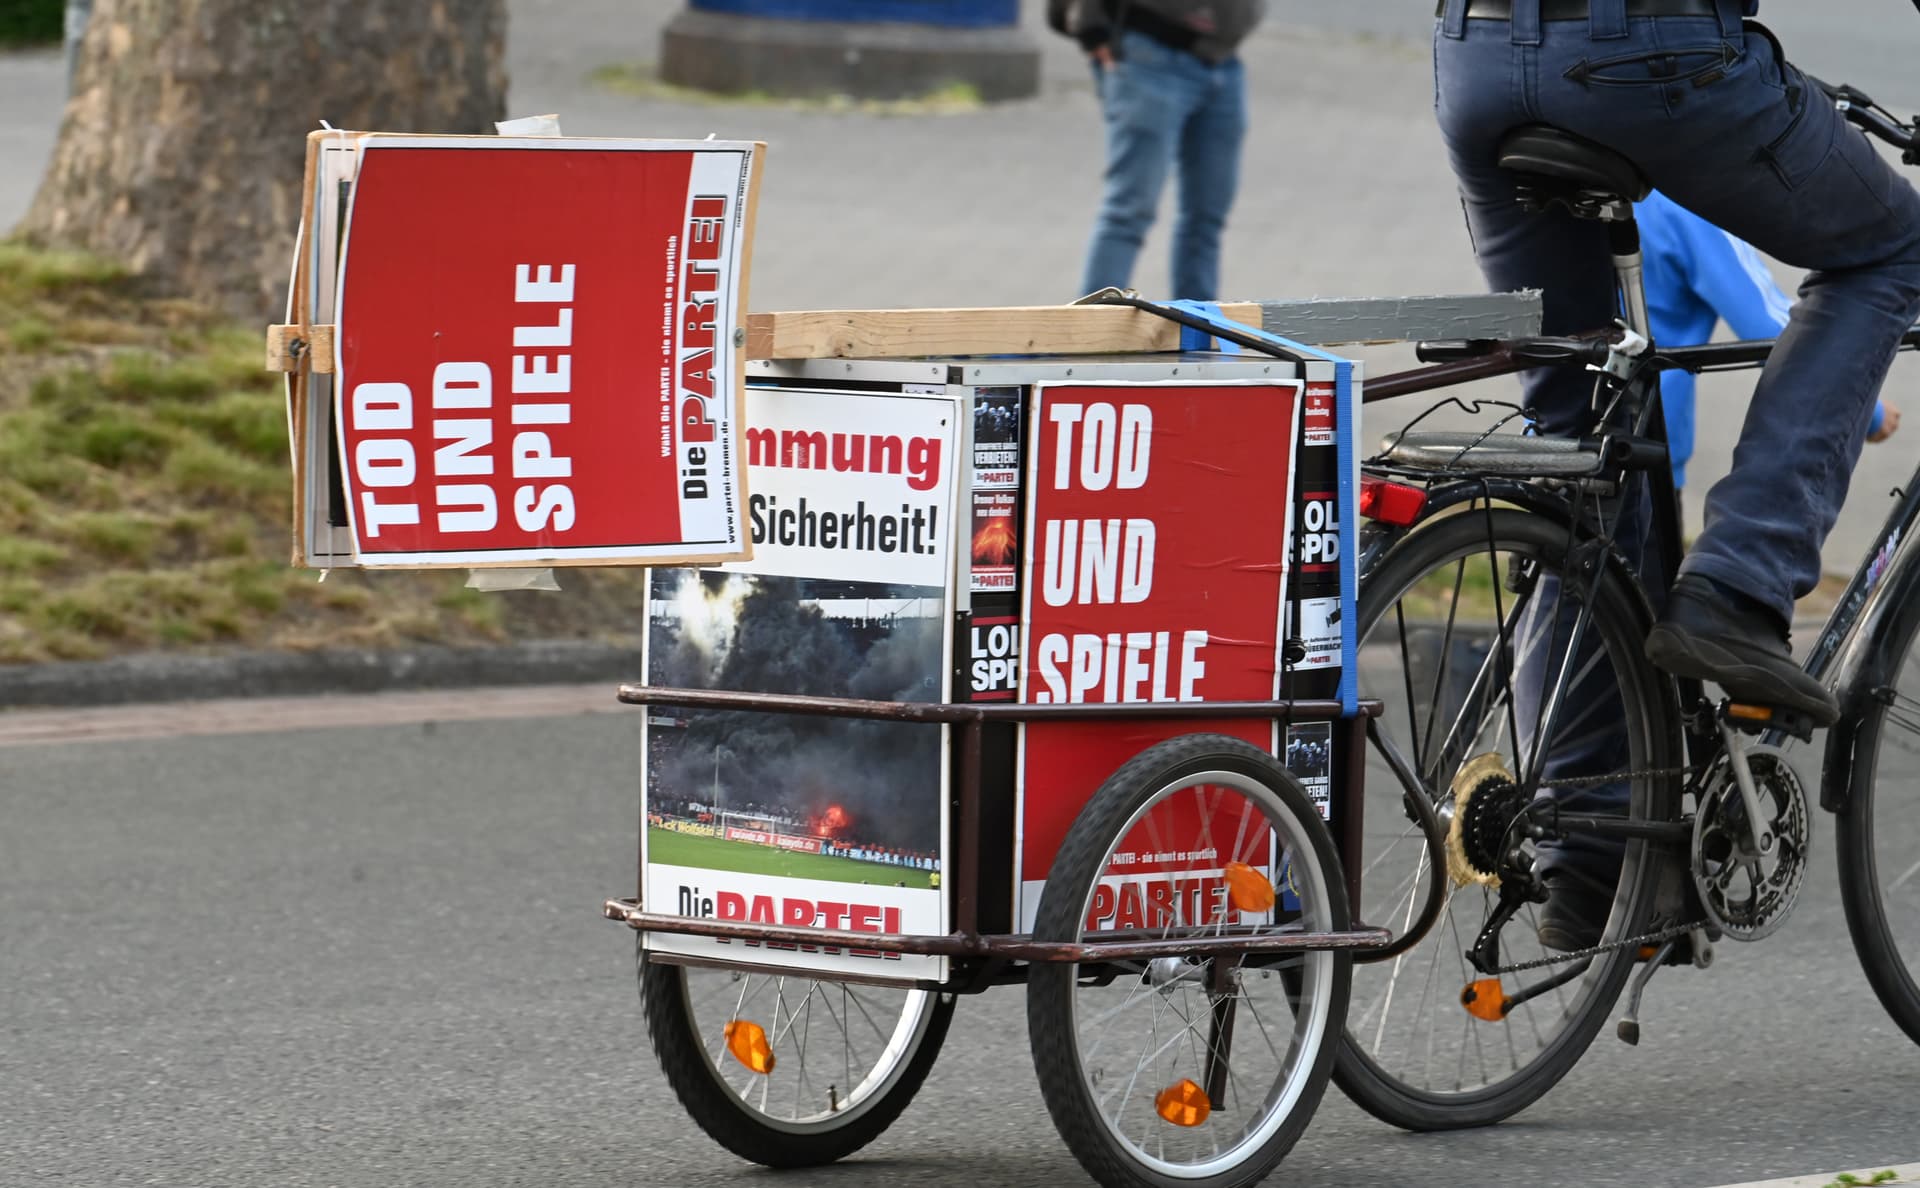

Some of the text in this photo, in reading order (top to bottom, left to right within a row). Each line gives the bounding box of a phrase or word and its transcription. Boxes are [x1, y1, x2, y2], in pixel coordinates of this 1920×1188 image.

[664, 236, 678, 283] sportlich
[662, 301, 673, 336] nimmt
[665, 286, 674, 299] es
[661, 339, 671, 356] sie
[682, 194, 728, 500] Die PARTEI
[511, 263, 576, 533] SPIELE
[661, 367, 672, 402] PARTEI
[661, 404, 671, 422] Die
[352, 382, 420, 538] TOD
[432, 361, 498, 533] UND
[660, 425, 672, 457] Wählt
[1049, 402, 1153, 491] TOD
[721, 420, 737, 544] www.partei-bremen.de
[984, 473, 1014, 482] PARTEI
[749, 494, 938, 555] Sicherheit!
[980, 576, 1014, 586] PARTEI
[1043, 518, 1156, 606] UND
[1036, 630, 1208, 704] SPIELE
[1112, 853, 1136, 865] PARTEI
[1142, 851, 1153, 863] sie
[1177, 850, 1186, 860] es
[1187, 848, 1217, 862] sportlich
[679, 886, 901, 960] Die PARTEI
